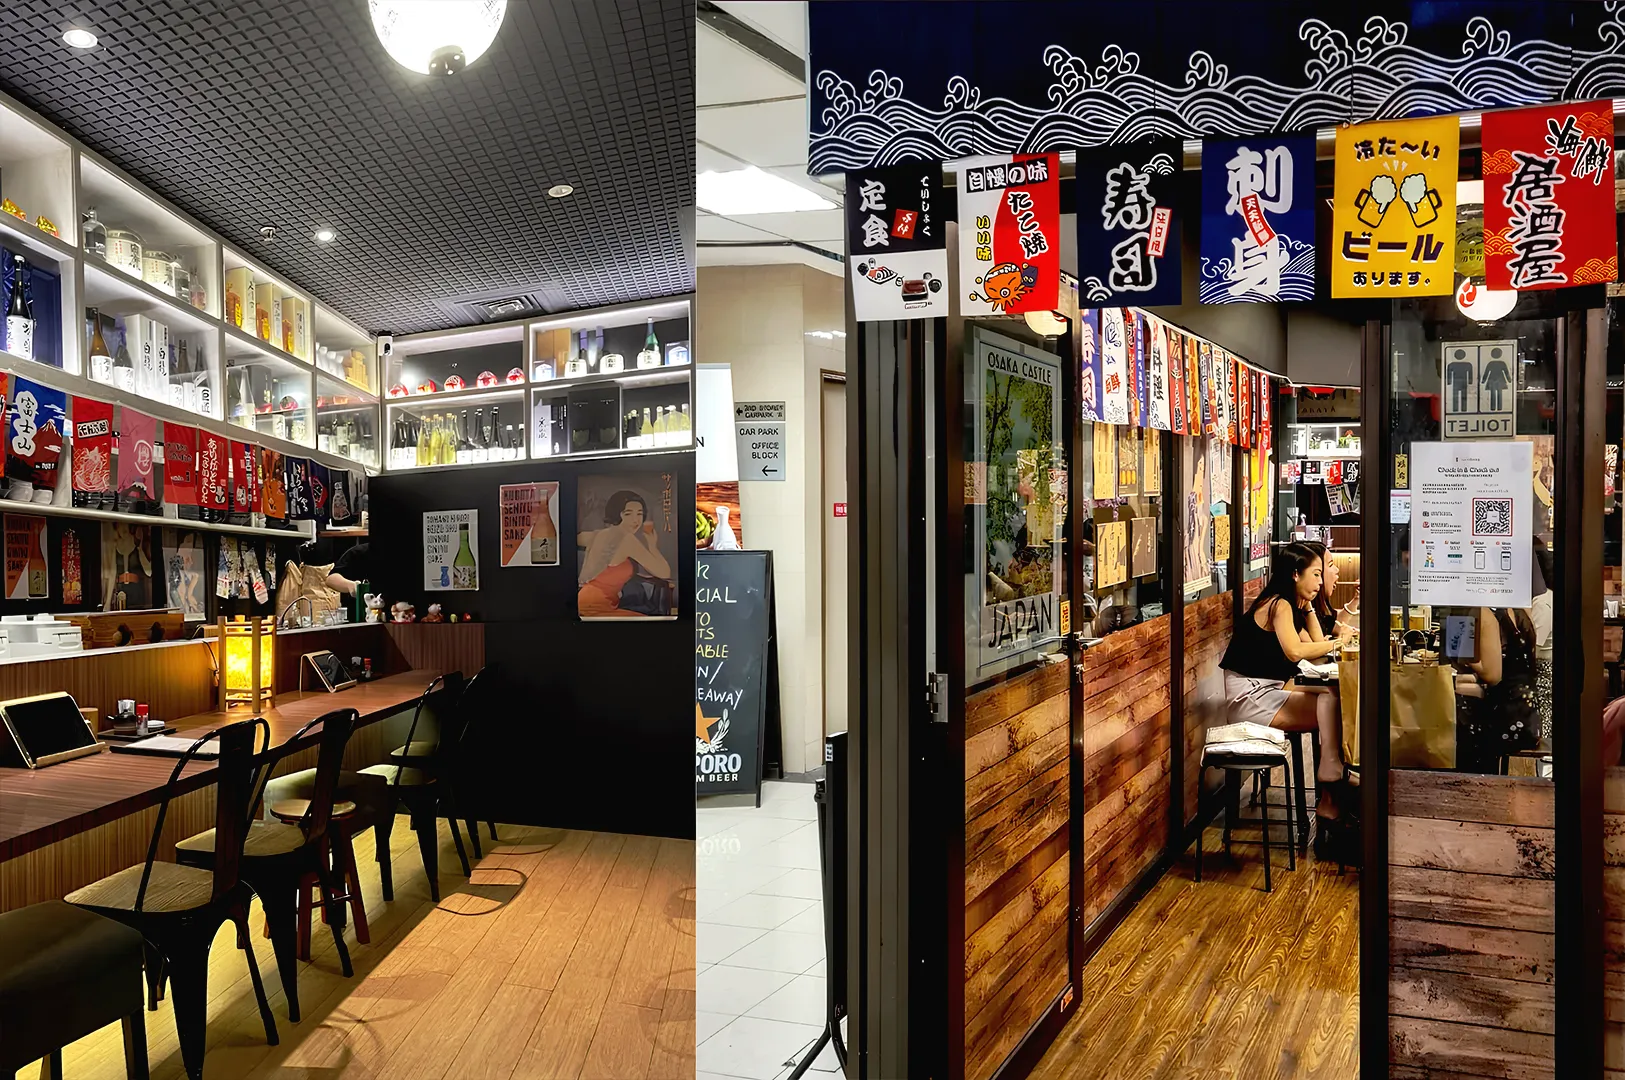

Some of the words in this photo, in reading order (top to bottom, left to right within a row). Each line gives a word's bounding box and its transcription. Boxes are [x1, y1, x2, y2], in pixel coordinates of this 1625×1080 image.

[1545, 114, 1611, 185] 海鮮
[967, 160, 1048, 192] 自慢の味
[860, 179, 889, 248] 定食
[920, 176, 931, 237] ていしょく
[1008, 191, 1048, 259] たこ焼
[1101, 162, 1157, 291] 寿司
[1225, 146, 1294, 296] 刺身
[1503, 150, 1567, 289] 居酒屋
[976, 215, 992, 261] いい味
[1342, 231, 1444, 264] ビール
[1352, 271, 1431, 287] あります。
[987, 352, 1018, 374] OSAKA
[1022, 363, 1051, 383] CASTLE
[18, 397, 34, 451] 富士山
[751, 451, 779, 459] BLOCK
[504, 529, 525, 540] SAKE
[988, 593, 1052, 648] JAPAN
[696, 644, 729, 658] ABLE
[709, 773, 738, 782] BEER
